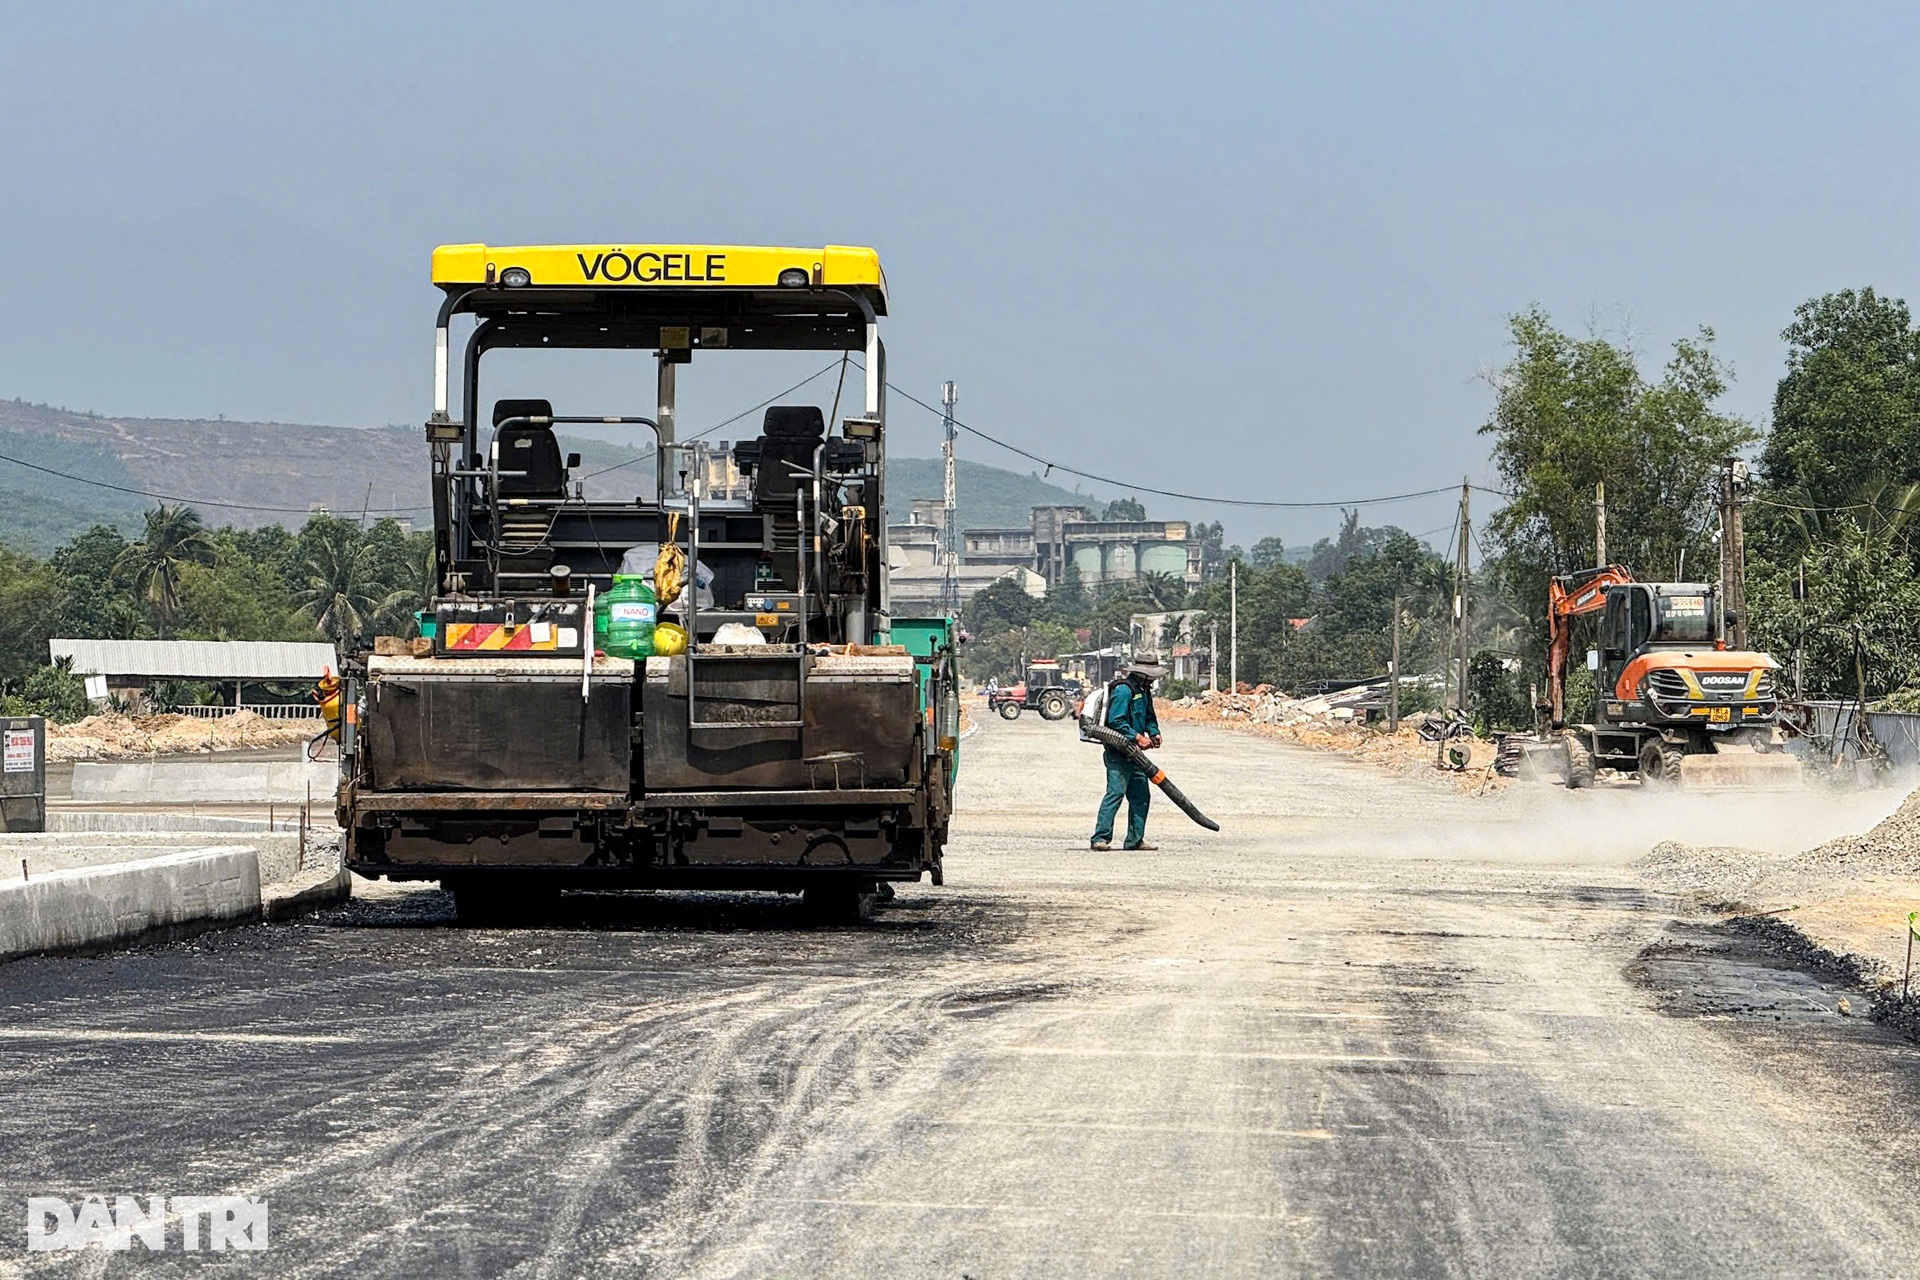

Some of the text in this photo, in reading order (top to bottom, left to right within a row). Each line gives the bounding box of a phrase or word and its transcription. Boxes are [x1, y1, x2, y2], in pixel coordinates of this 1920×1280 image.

[576, 248, 726, 283] VÖGELE
[623, 607, 649, 617] NANO
[1702, 676, 1745, 685] DOOSAN
